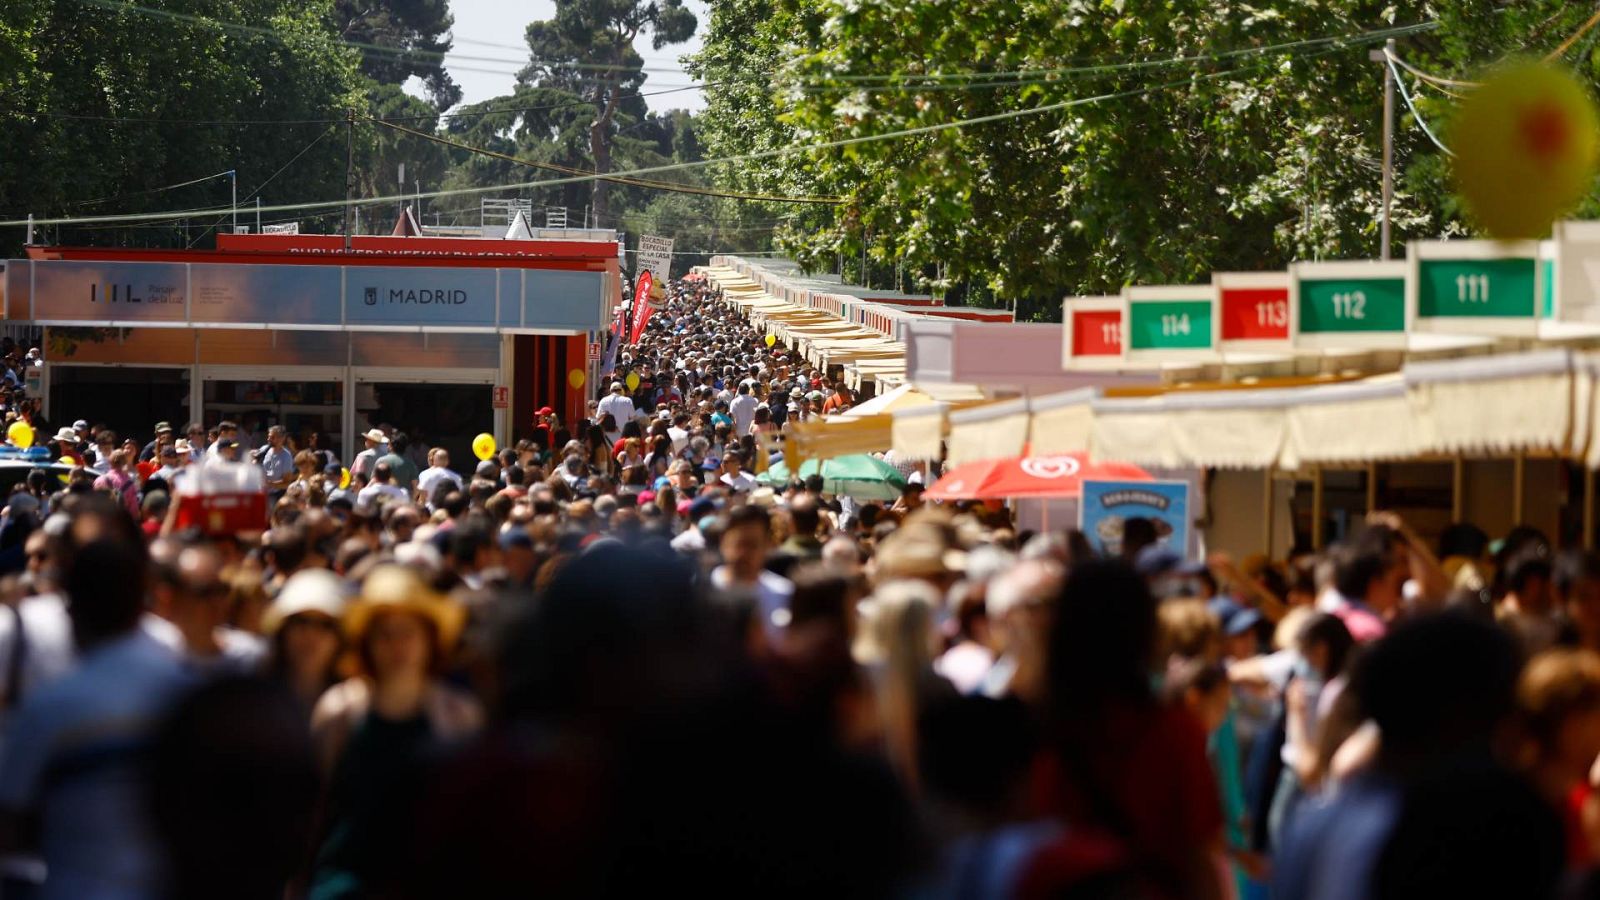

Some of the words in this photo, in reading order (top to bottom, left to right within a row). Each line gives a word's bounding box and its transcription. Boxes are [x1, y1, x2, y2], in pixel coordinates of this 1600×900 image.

[389, 289, 467, 305] MADRID
[1455, 273, 1489, 303] 111
[1255, 301, 1288, 328] 113
[1331, 290, 1366, 319] 112
[1161, 313, 1191, 337] 114
